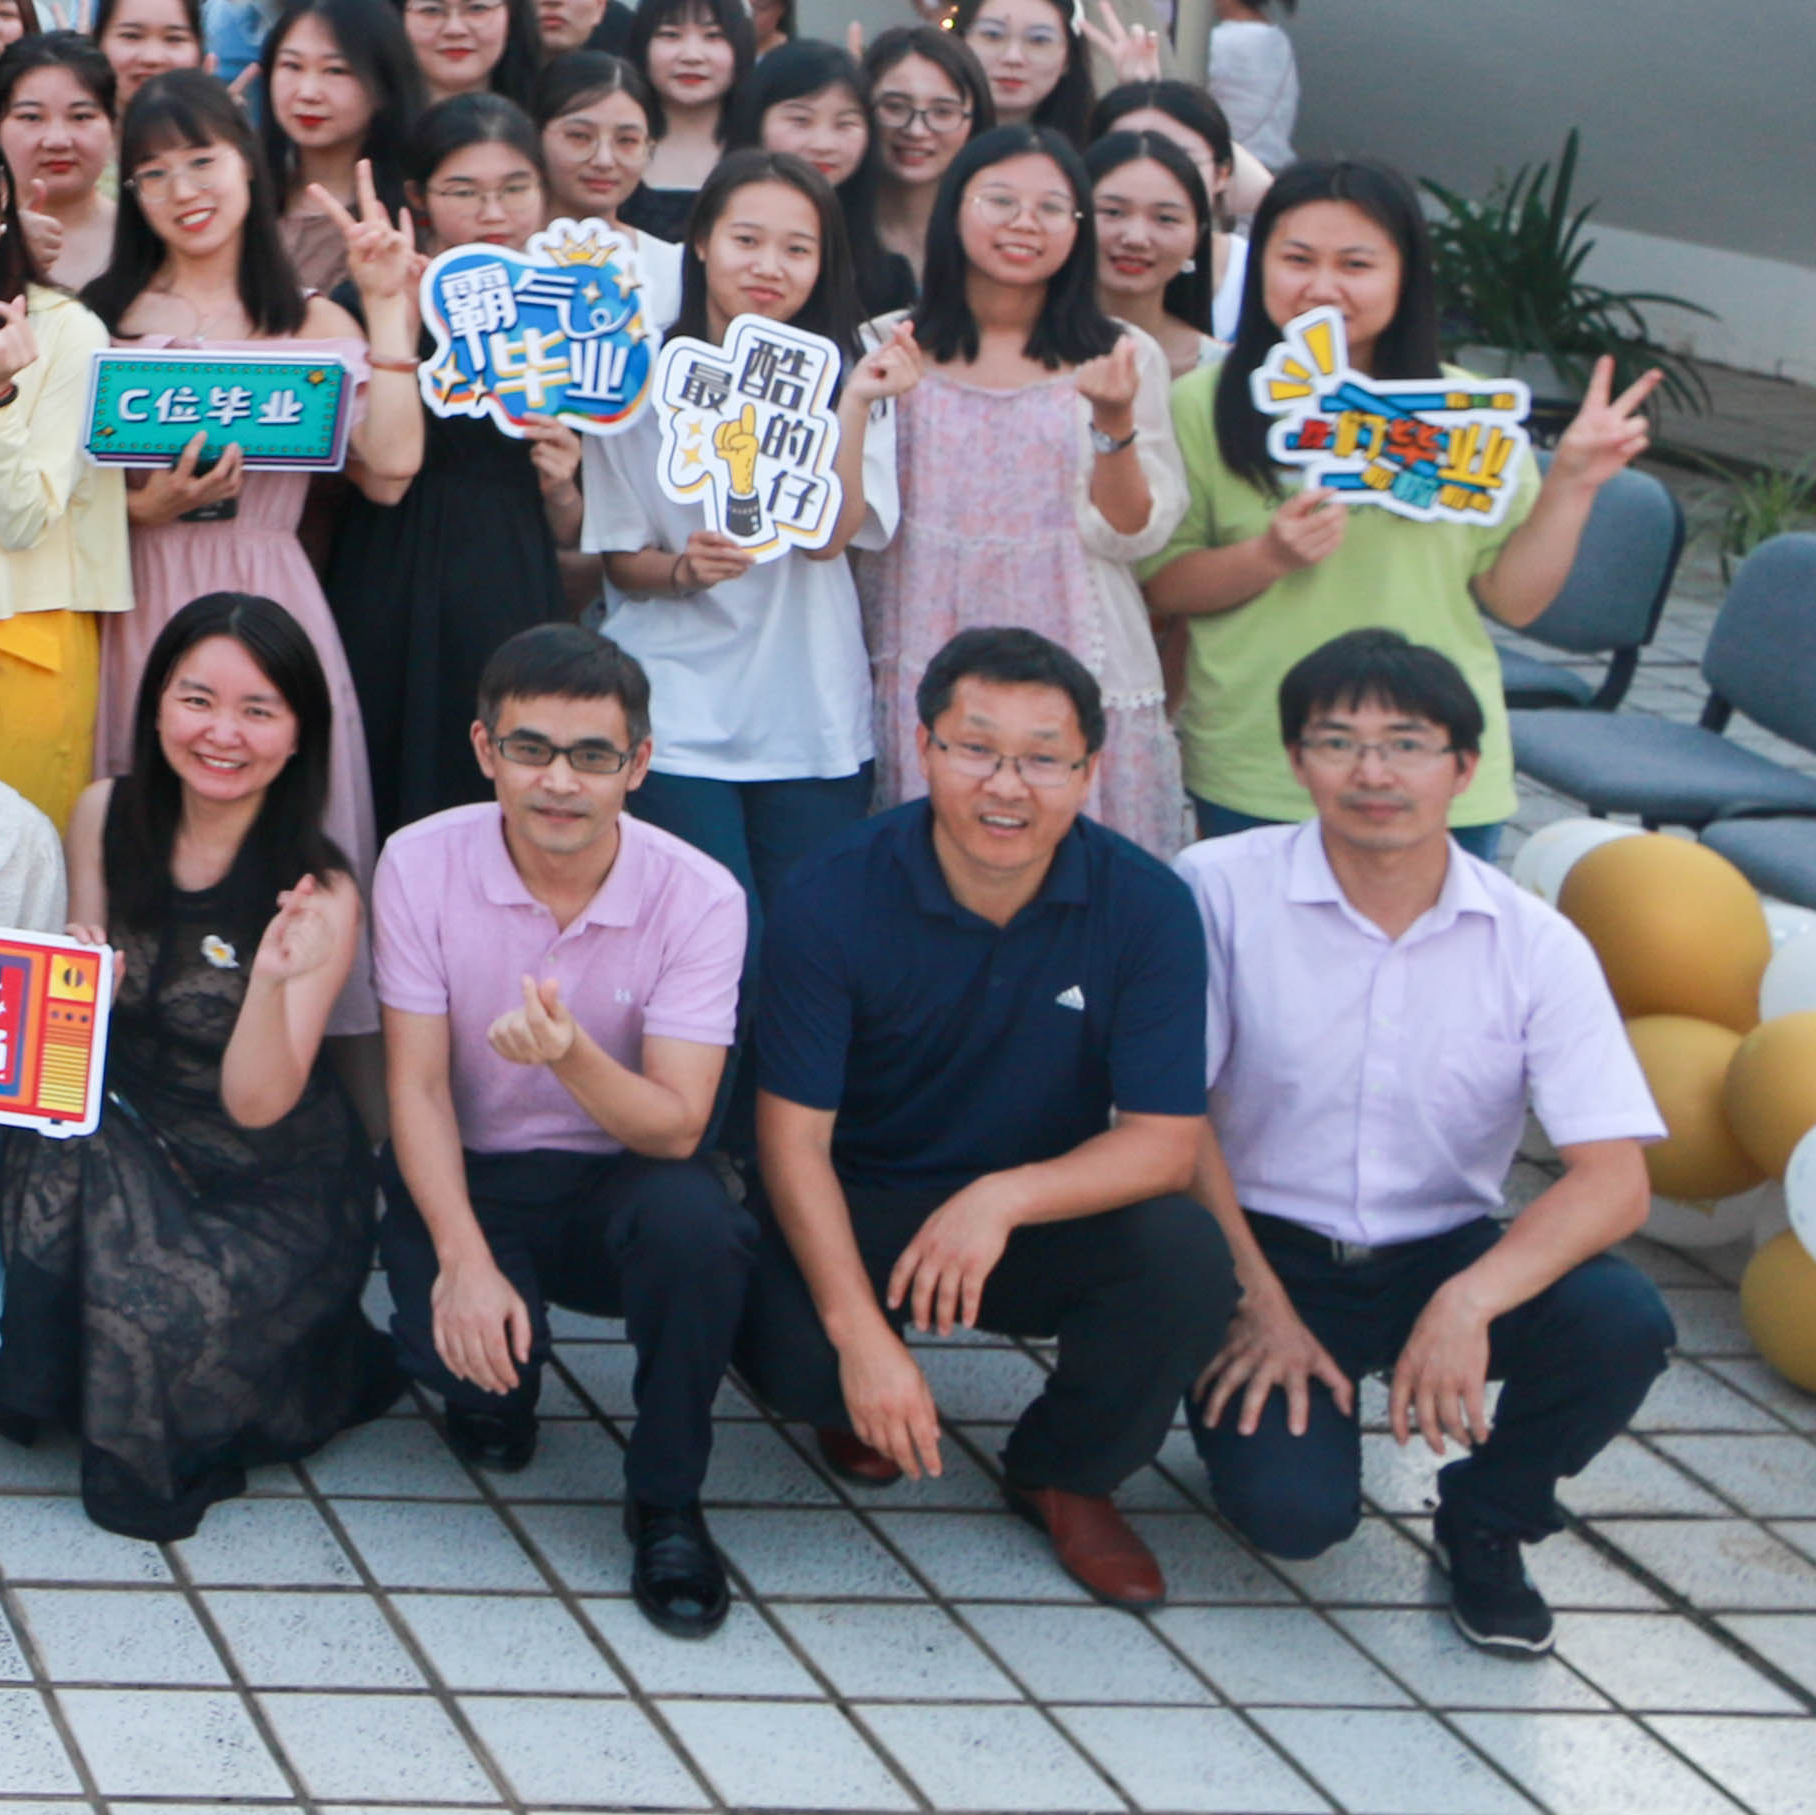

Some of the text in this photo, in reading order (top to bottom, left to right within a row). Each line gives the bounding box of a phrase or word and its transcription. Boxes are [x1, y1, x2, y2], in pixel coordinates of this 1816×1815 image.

[440, 262, 631, 373] 霸气
[117, 385, 306, 429] C位毕业
[489, 328, 630, 409] 毕业
